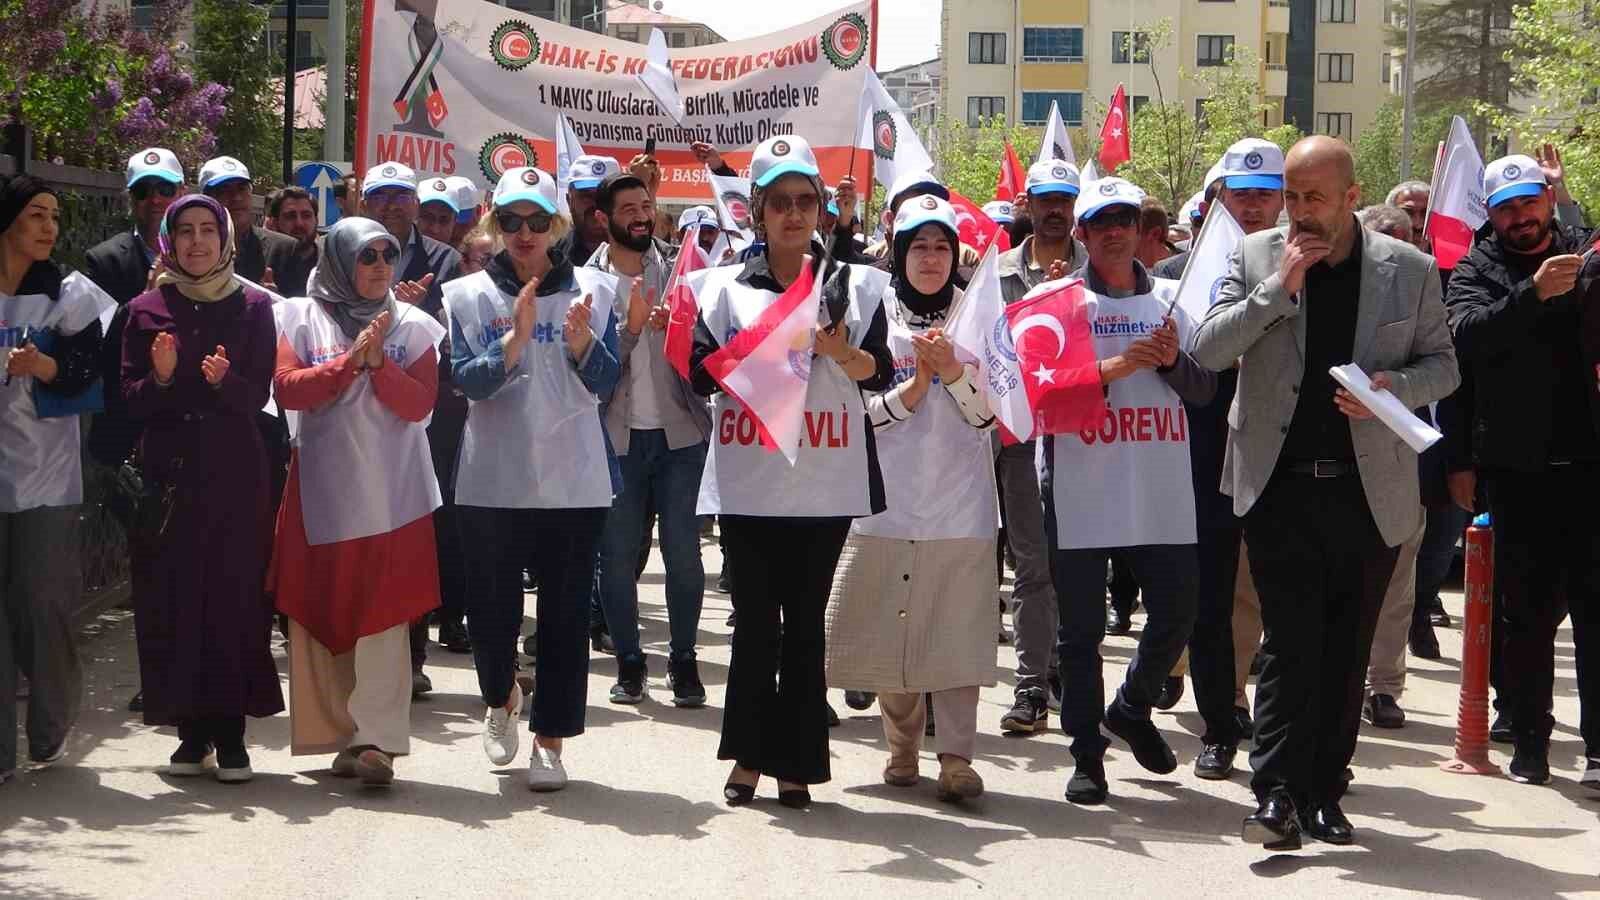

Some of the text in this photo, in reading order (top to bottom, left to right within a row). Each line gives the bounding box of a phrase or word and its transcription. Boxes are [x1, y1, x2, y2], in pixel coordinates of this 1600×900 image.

[622, 34, 819, 81] KFEDERASYONU
[538, 84, 546, 105] 1
[550, 85, 593, 112] MAYIS
[686, 92, 729, 117] Birlik,
[733, 82, 800, 113] Mücadele
[804, 85, 819, 107] ve
[716, 120, 753, 145] Kutlu
[376, 134, 456, 175] MAYIS
[719, 402, 849, 448] GÖVLİ
[1079, 400, 1186, 445] GÖREVLİ
